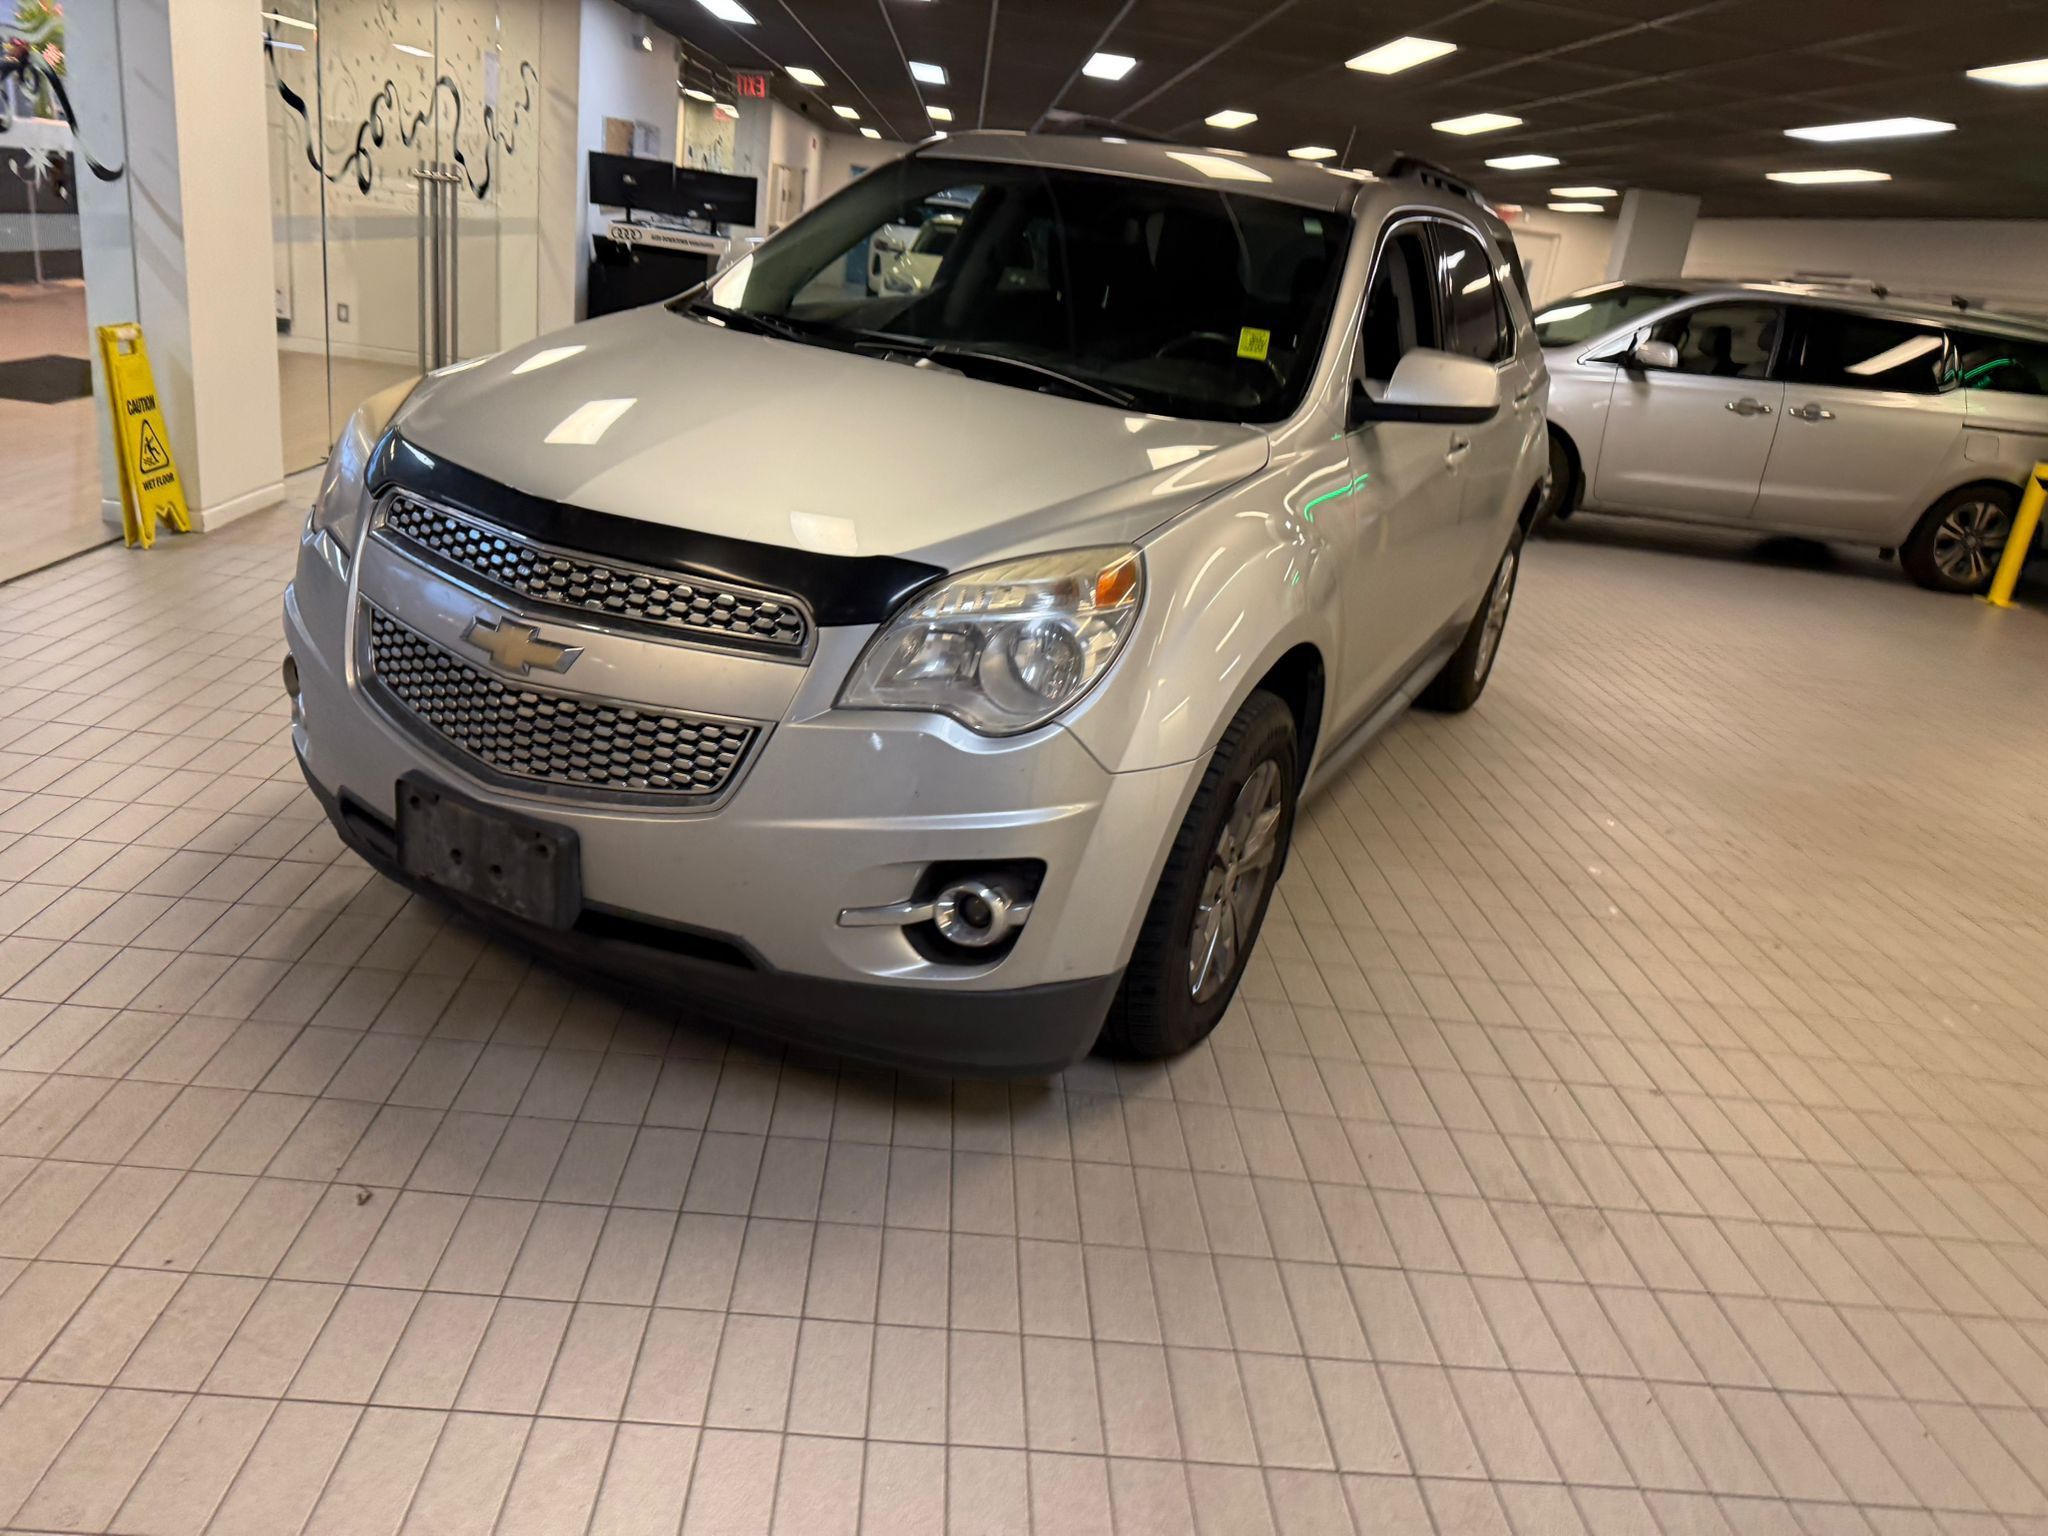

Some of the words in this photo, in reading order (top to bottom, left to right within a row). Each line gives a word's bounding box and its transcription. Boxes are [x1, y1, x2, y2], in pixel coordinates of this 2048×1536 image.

[127, 394, 156, 415] CAUTION
[142, 478, 156, 491] WET
[156, 472, 175, 487] FLOOR
